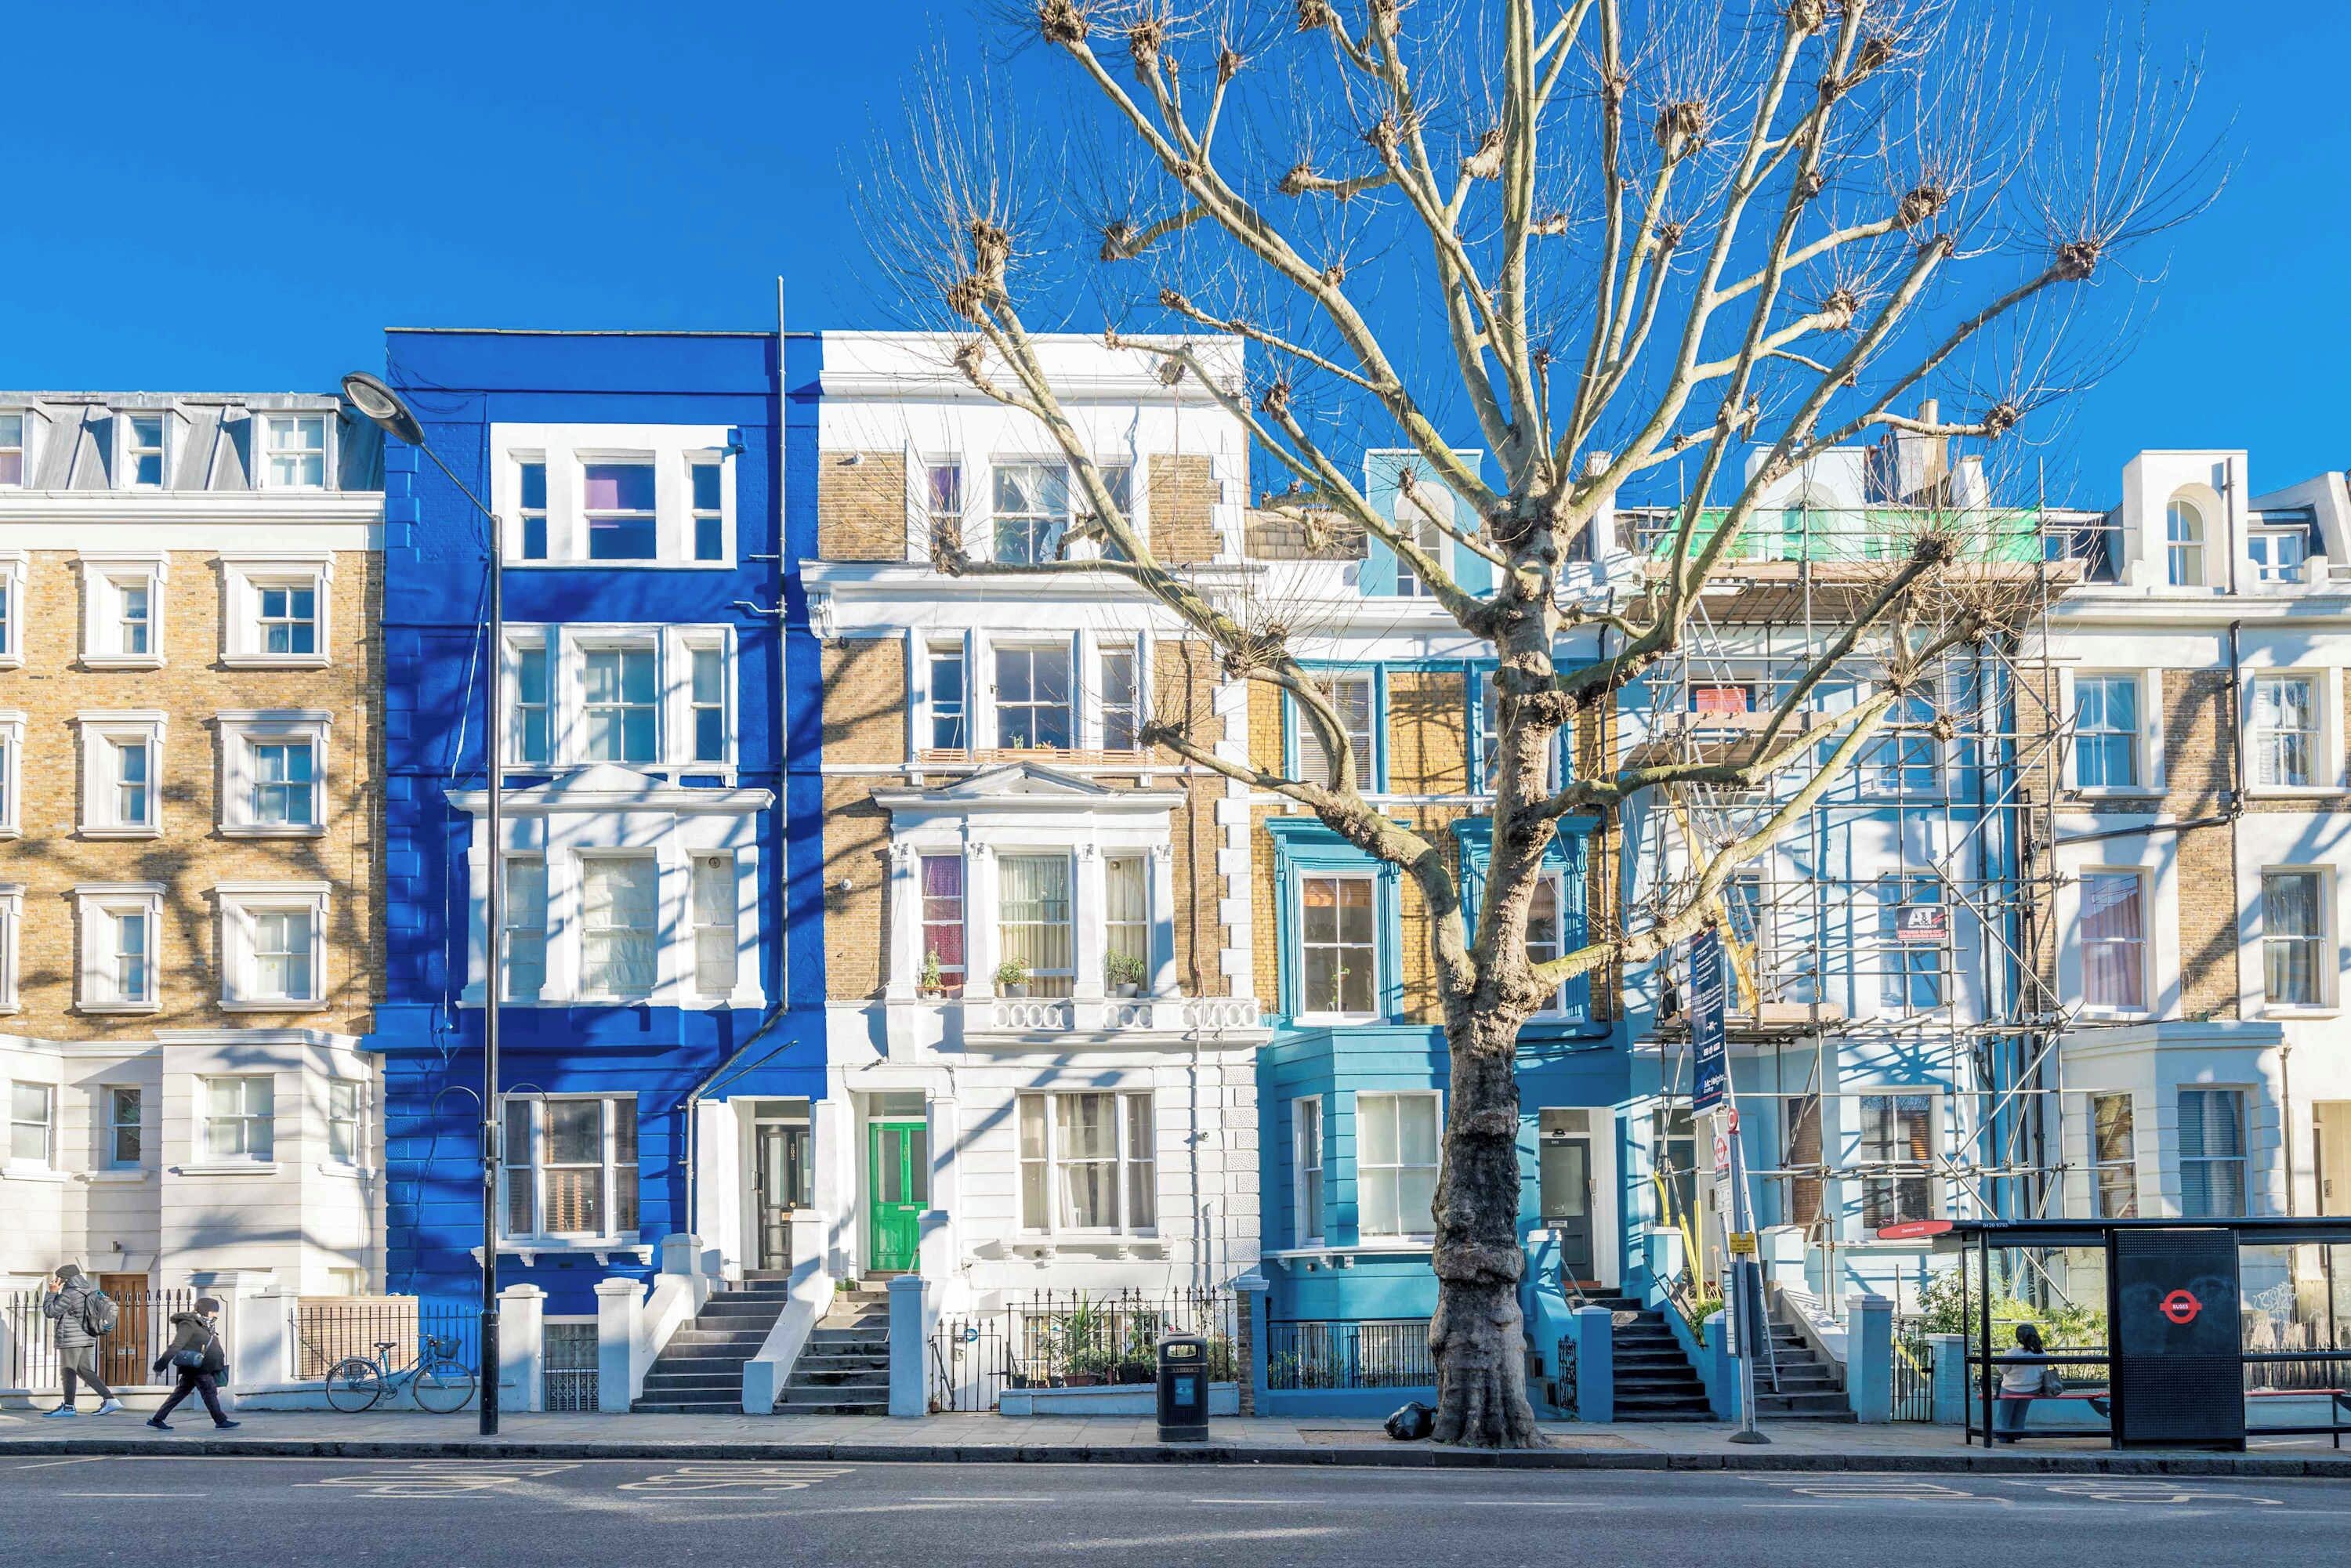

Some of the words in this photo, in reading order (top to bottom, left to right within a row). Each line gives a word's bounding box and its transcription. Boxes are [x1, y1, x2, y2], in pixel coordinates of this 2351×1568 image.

[1728, 1111, 1735, 1129] C
[290, 1462, 583, 1494] STOP
[617, 1466, 856, 1491] BUS
